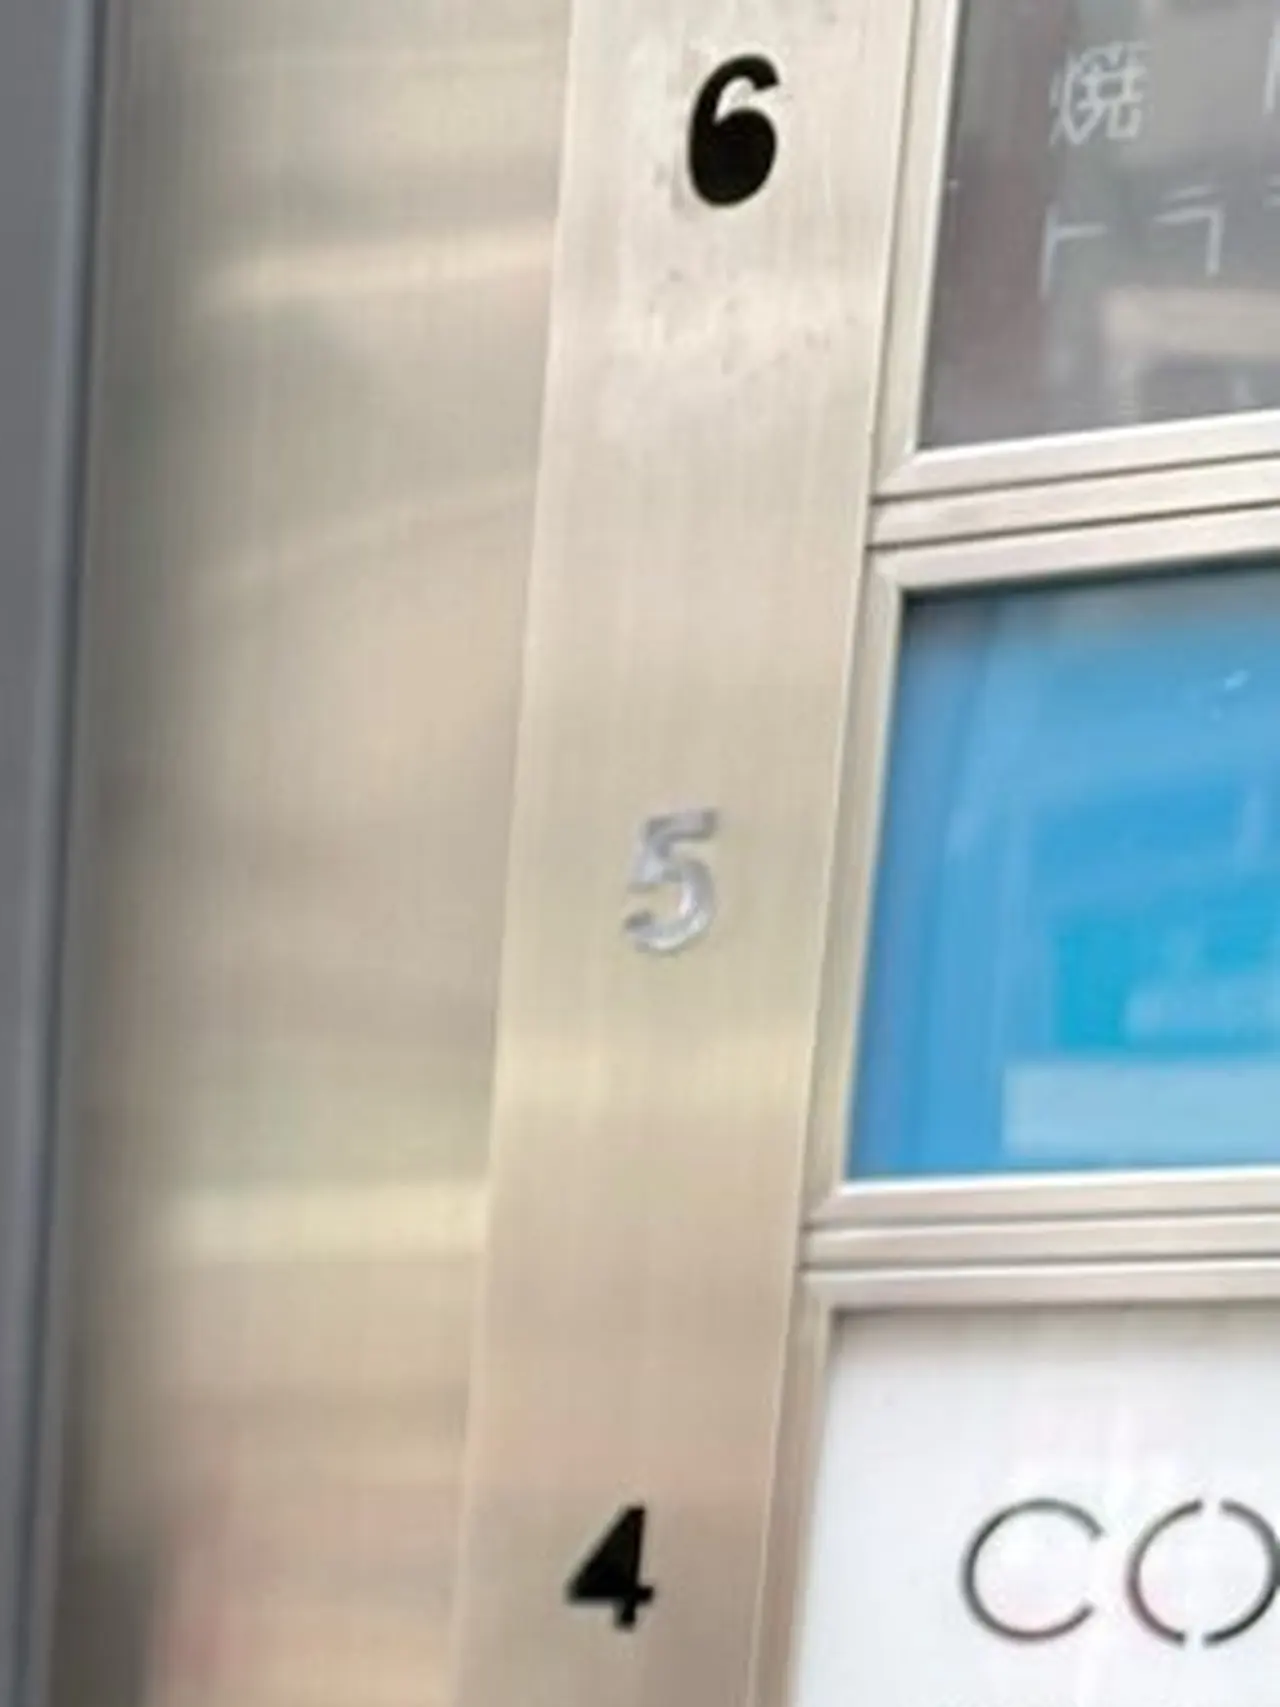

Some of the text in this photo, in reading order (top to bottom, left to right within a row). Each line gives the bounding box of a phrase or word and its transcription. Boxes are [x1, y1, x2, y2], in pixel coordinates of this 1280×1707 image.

[688, 55, 780, 207] 6
[623, 808, 717, 954] 5
[565, 1503, 656, 1632] 4
